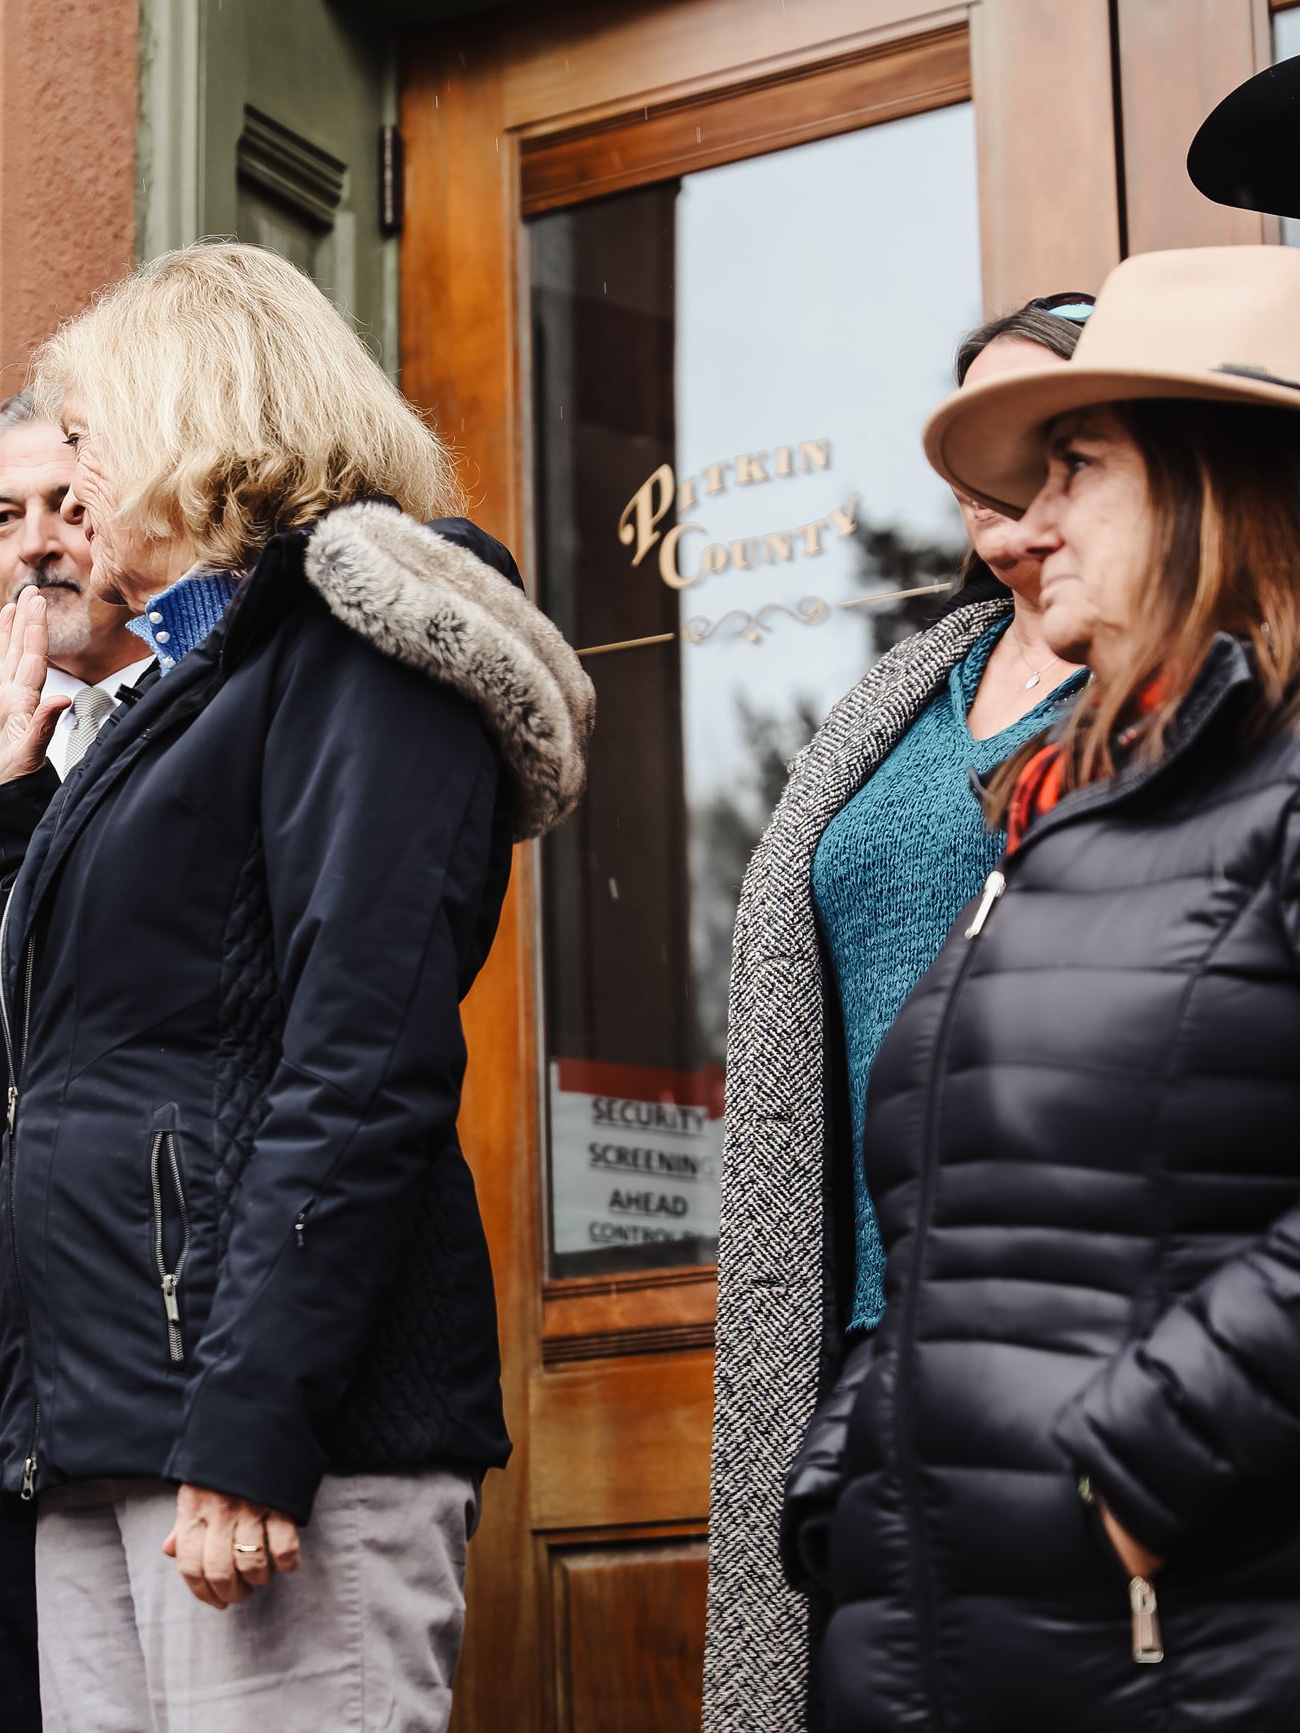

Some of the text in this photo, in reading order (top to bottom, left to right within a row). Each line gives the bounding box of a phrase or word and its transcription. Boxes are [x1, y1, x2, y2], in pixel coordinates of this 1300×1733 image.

[618, 437, 832, 567] PITKIN
[659, 491, 861, 590] COUNTY
[592, 1097, 706, 1131] SECURITY
[609, 1187, 688, 1216] AHEAD
